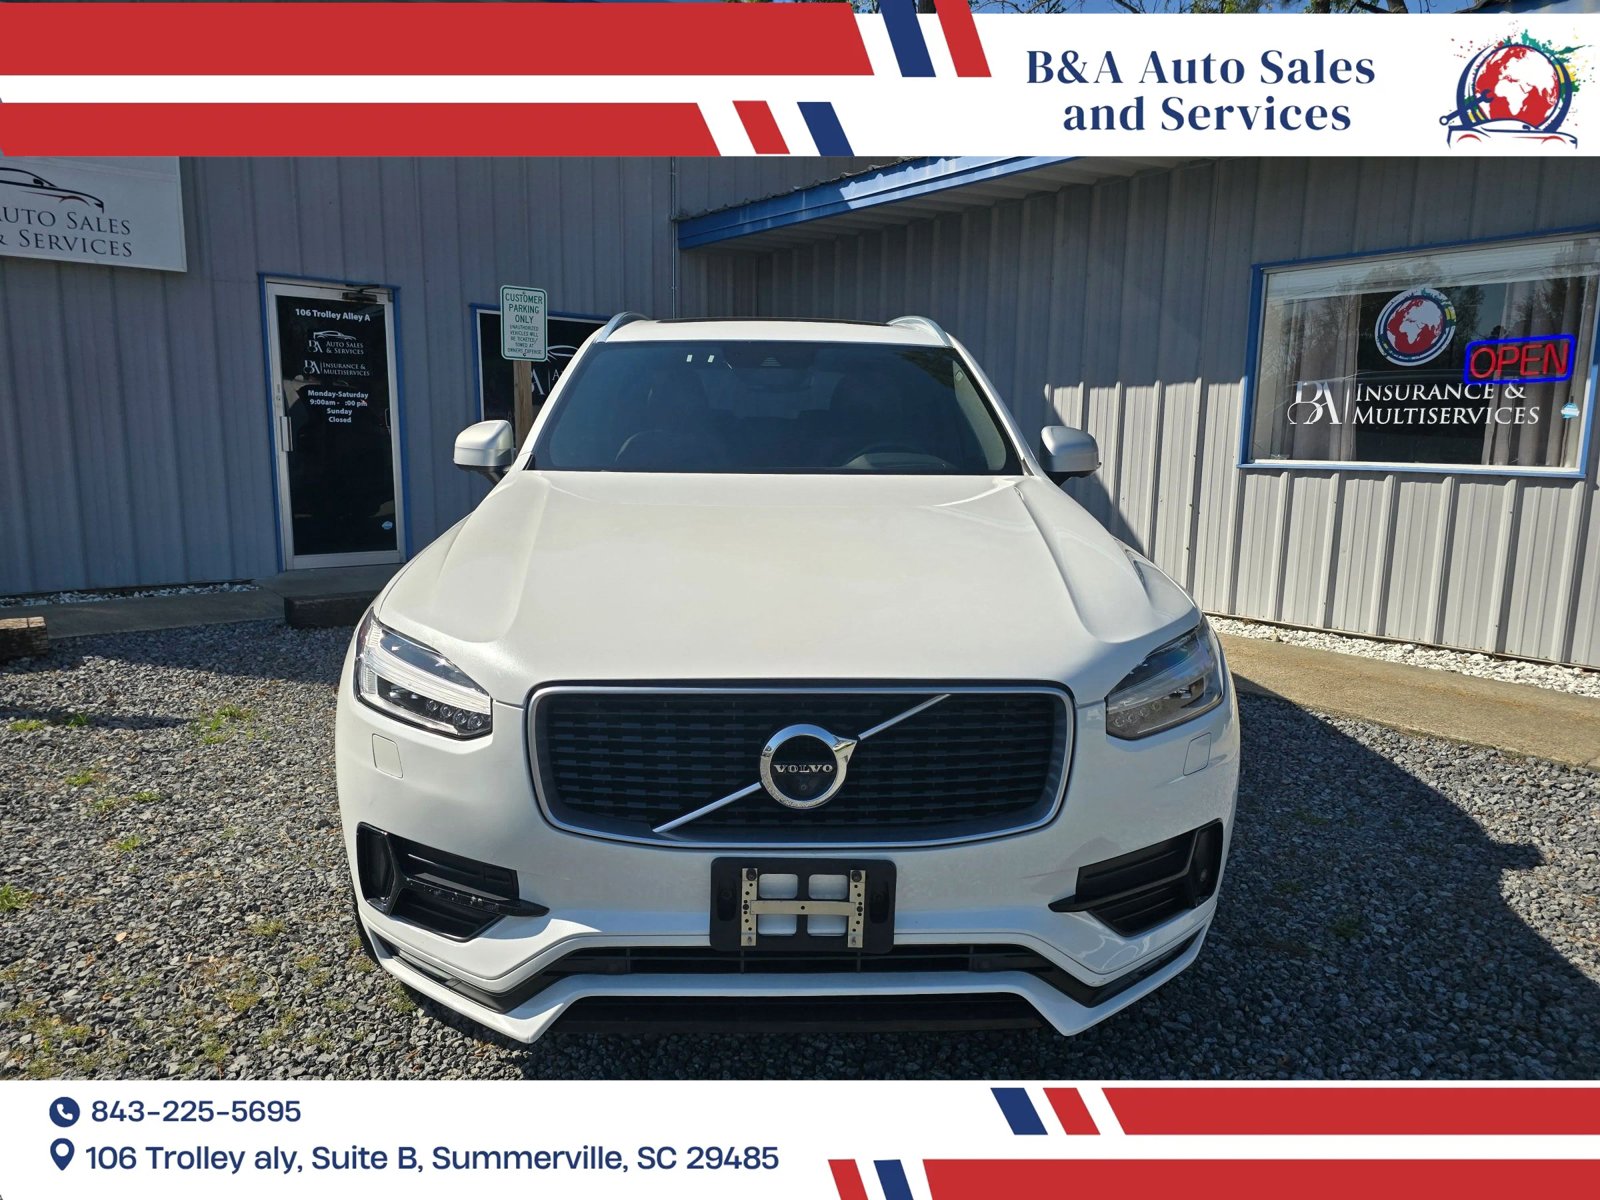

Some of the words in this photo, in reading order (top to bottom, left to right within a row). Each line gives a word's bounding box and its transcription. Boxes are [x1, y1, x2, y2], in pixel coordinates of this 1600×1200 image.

[0, 206, 56, 227] UTO
[66, 211, 131, 235] SALES
[19, 229, 133, 258] SERVICES
[505, 293, 543, 304] CUSTOMER
[508, 304, 540, 314] PARKING
[295, 308, 311, 317] 106
[312, 310, 341, 320] Trolley
[342, 312, 363, 322] Alley
[515, 314, 534, 324] ONLY
[345, 341, 364, 349] SALES
[334, 347, 364, 355] SERVICES
[1469, 342, 1569, 379] OPEN
[323, 362, 359, 370] INSURANCE
[307, 390, 369, 399] Monday-Saturday
[1355, 382, 1495, 403] INSURANCE
[1503, 379, 1528, 400] &
[1351, 405, 1541, 426] MULTISERVICES
[773, 764, 833, 773] VOLVO
